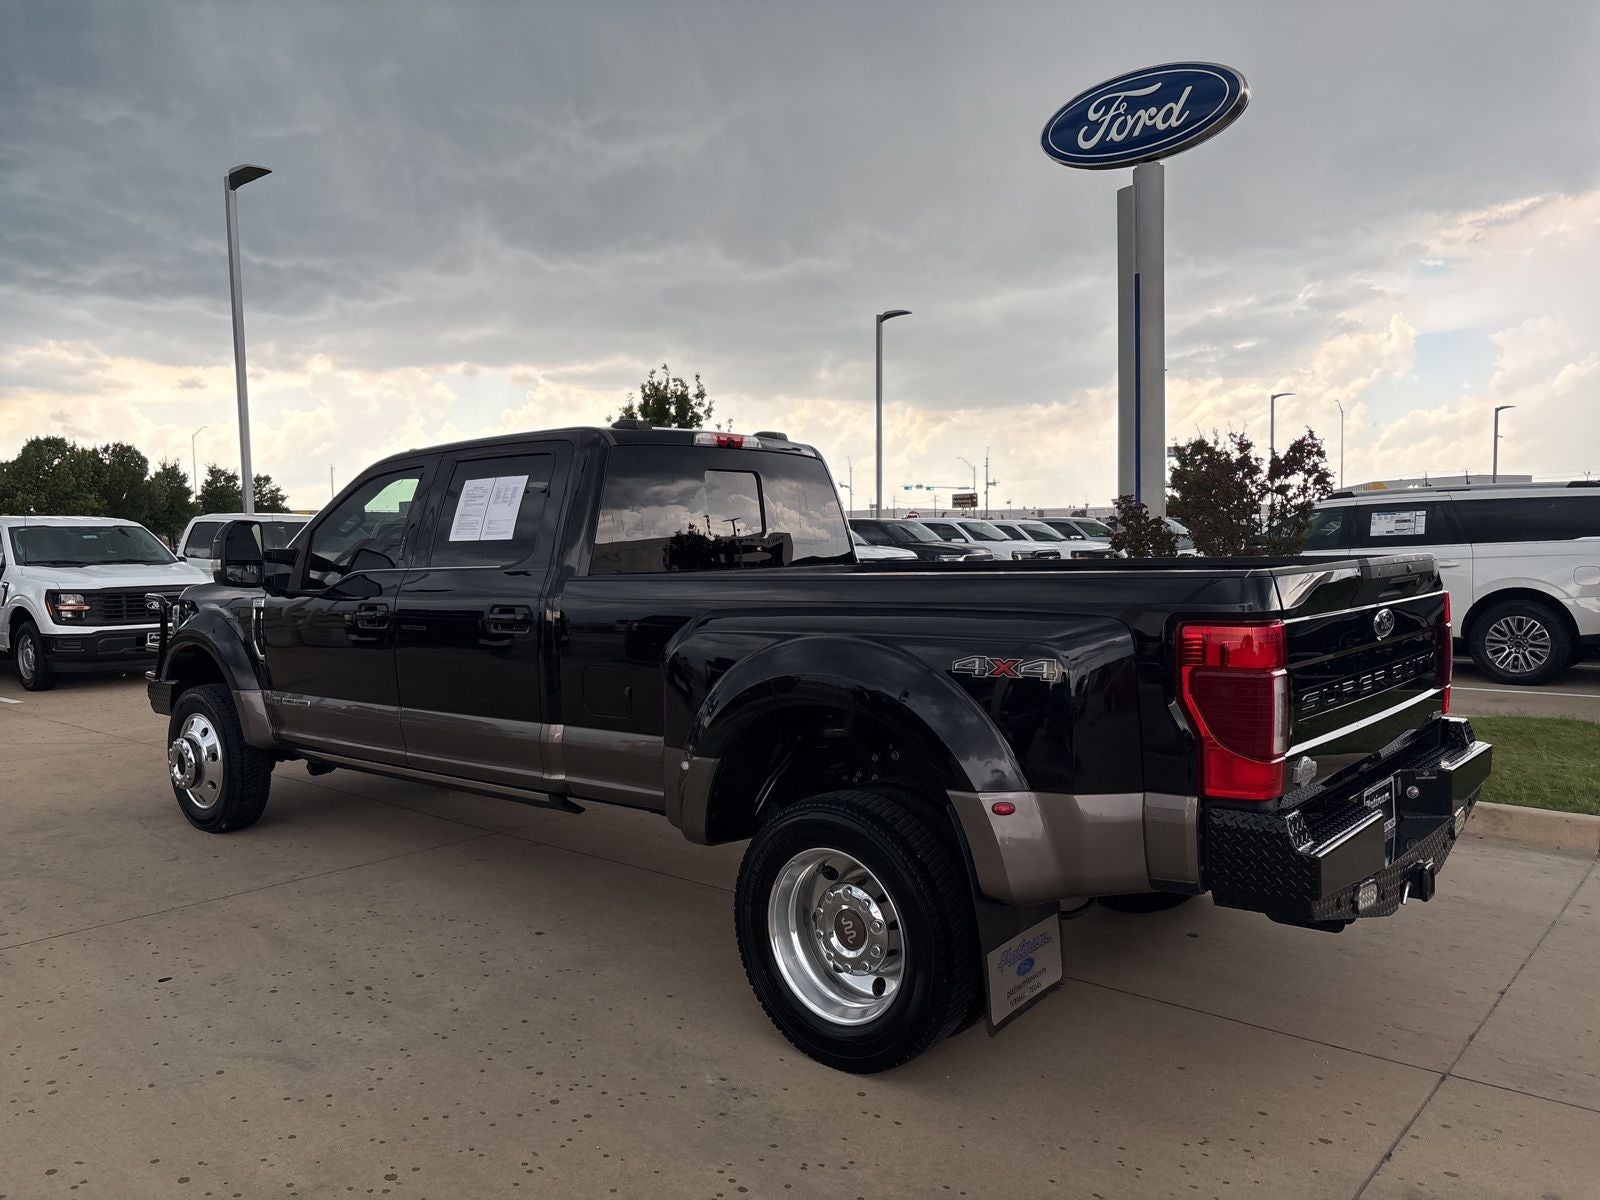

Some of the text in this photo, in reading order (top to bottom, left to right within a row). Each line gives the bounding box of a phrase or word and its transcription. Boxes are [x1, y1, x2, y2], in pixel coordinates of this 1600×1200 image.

[1077, 82, 1193, 150] Ford
[1301, 651, 1434, 712] SUPER DUTY
